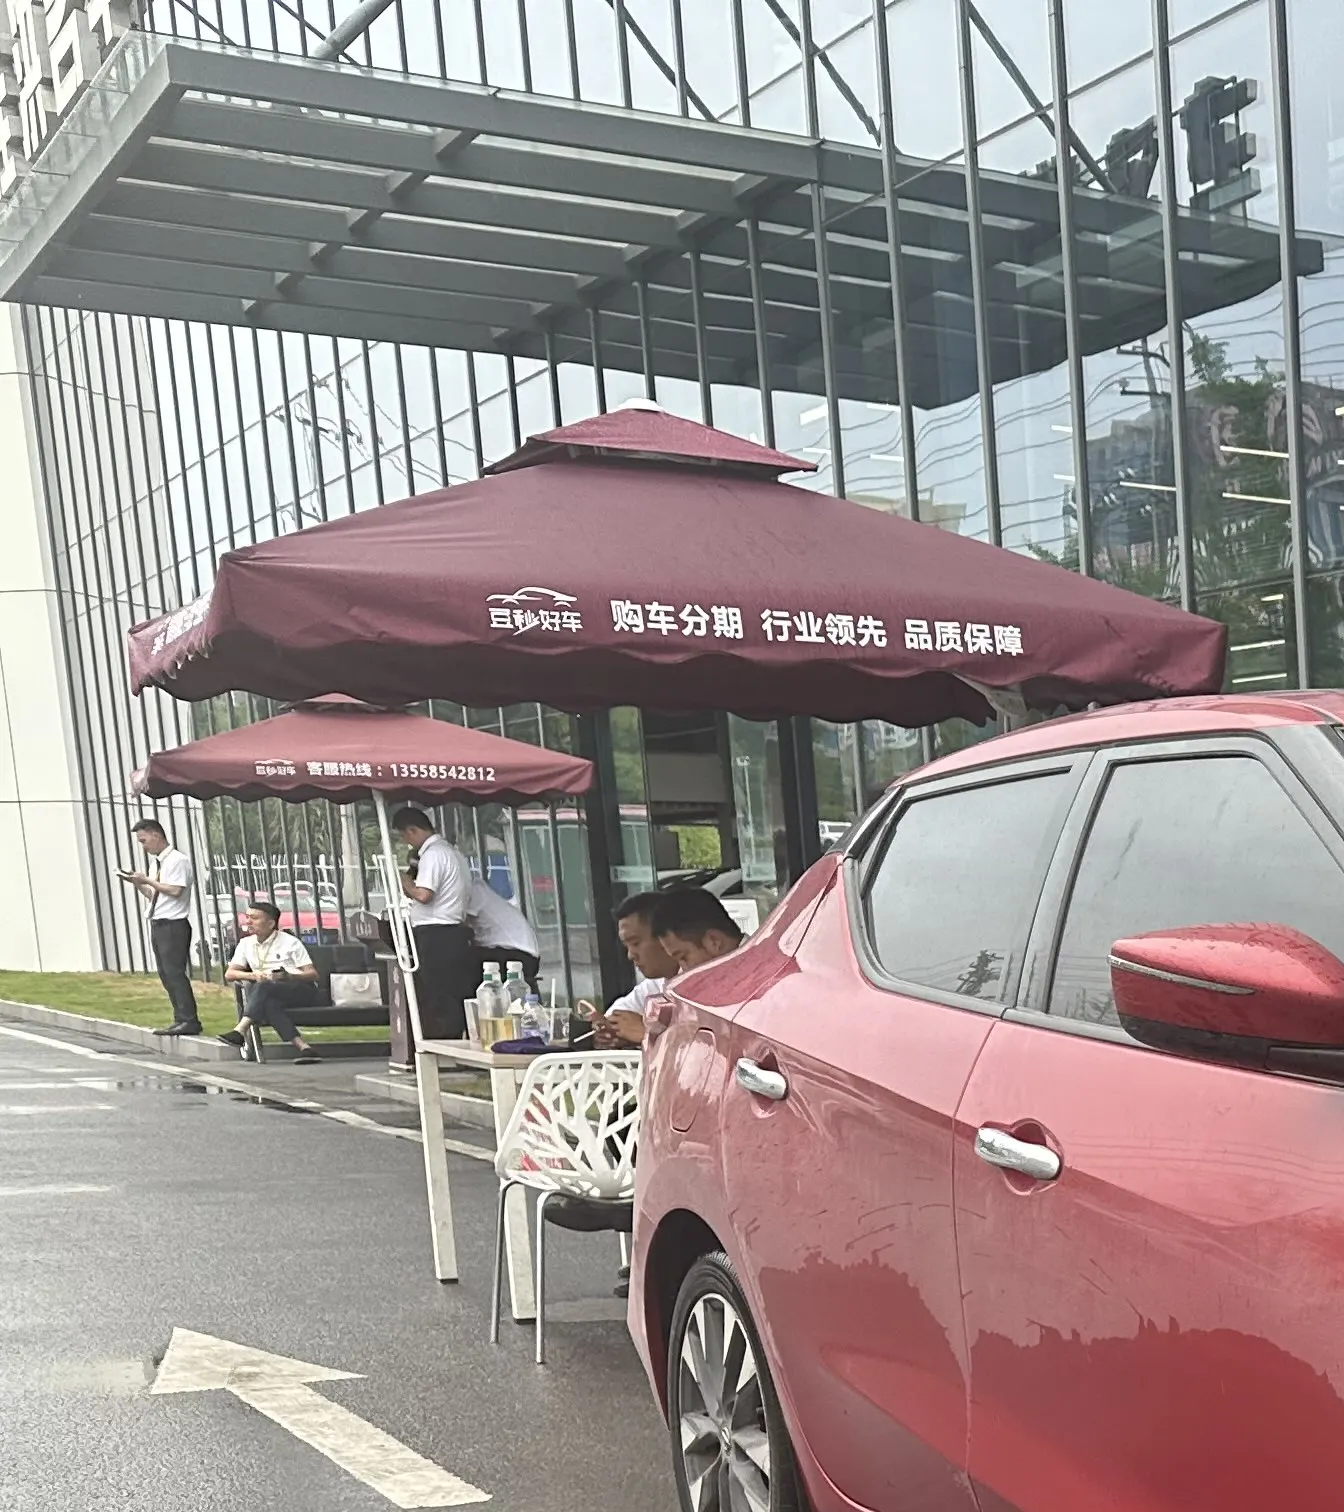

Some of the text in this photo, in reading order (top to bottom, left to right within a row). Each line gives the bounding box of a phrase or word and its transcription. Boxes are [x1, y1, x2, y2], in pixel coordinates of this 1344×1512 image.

[610, 599, 1025, 657] 购车分期 行业领先 品质保障
